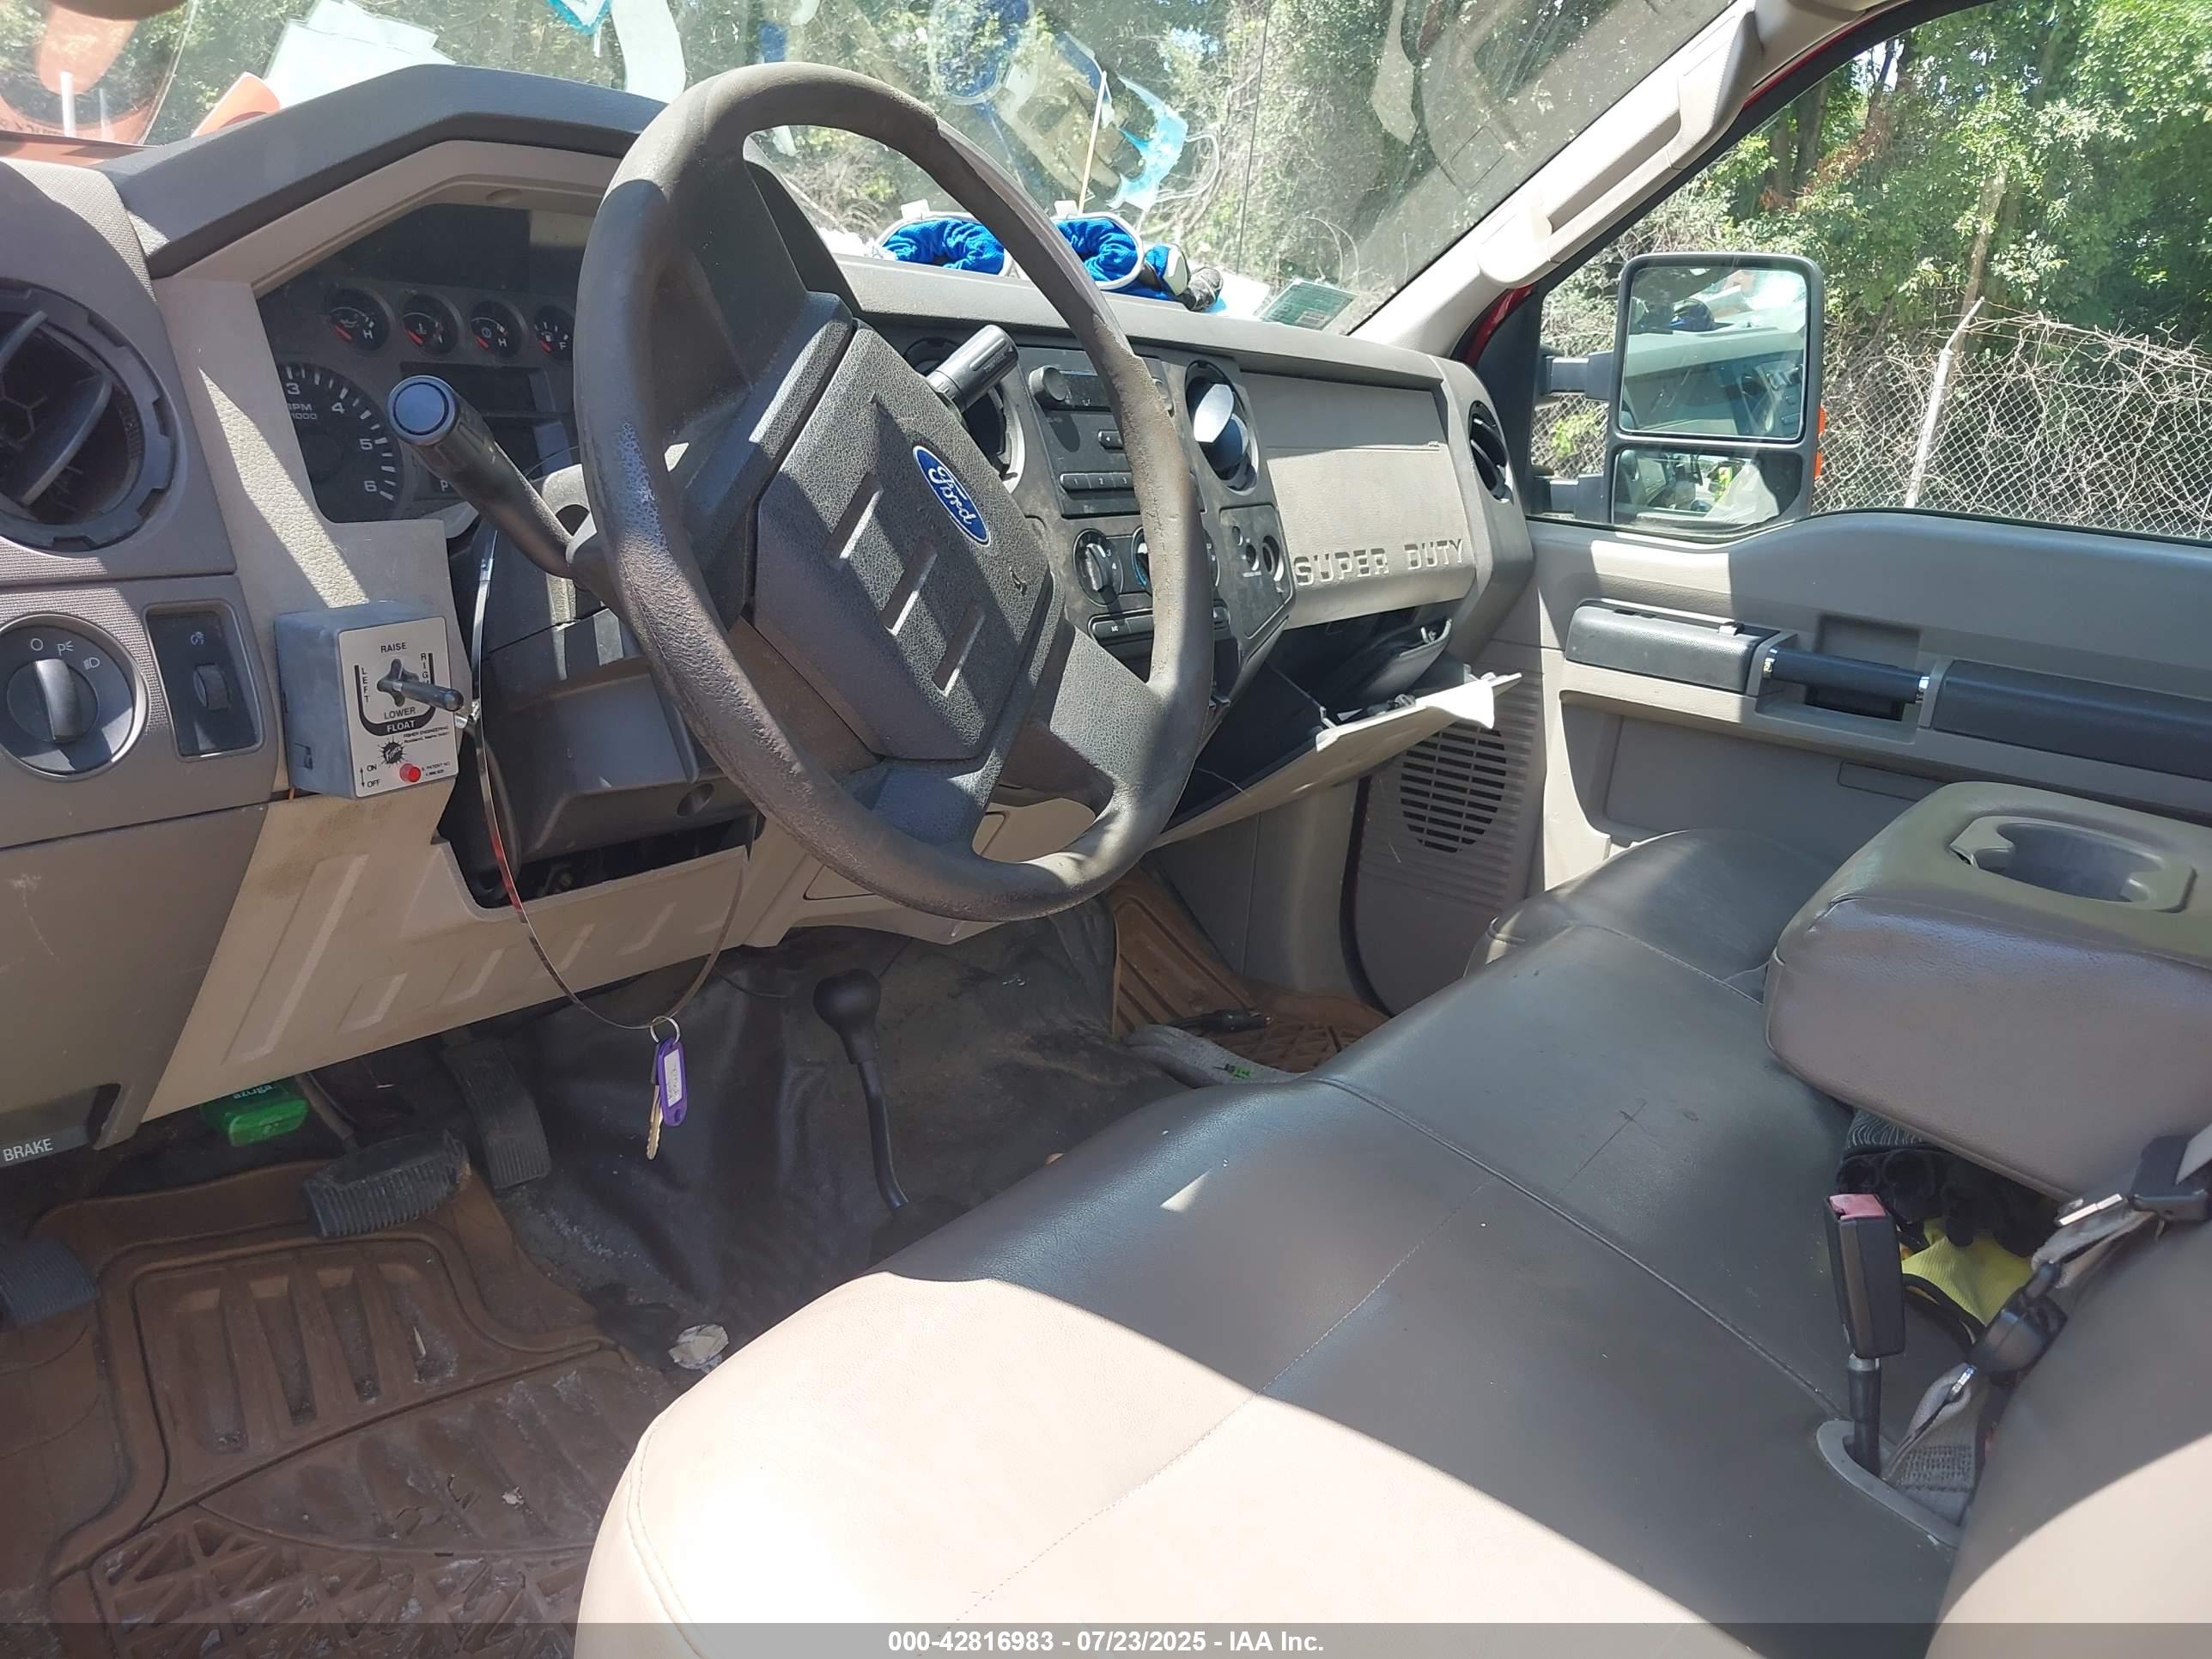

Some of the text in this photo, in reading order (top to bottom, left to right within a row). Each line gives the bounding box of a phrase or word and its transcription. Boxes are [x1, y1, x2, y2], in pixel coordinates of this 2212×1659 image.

[286, 382, 301, 395] 3
[331, 402, 345, 415] 4
[360, 439, 374, 452] 5
[364, 481, 378, 493] 6
[928, 465, 977, 526] Ford
[1293, 538, 1463, 586] SUPER DUTY
[380, 641, 407, 653] RAISE
[384, 707, 416, 720] LOWER
[386, 720, 416, 733] FLOAT
[368, 780, 380, 788] OFF
[3, 1138, 53, 1162] BRAKE
